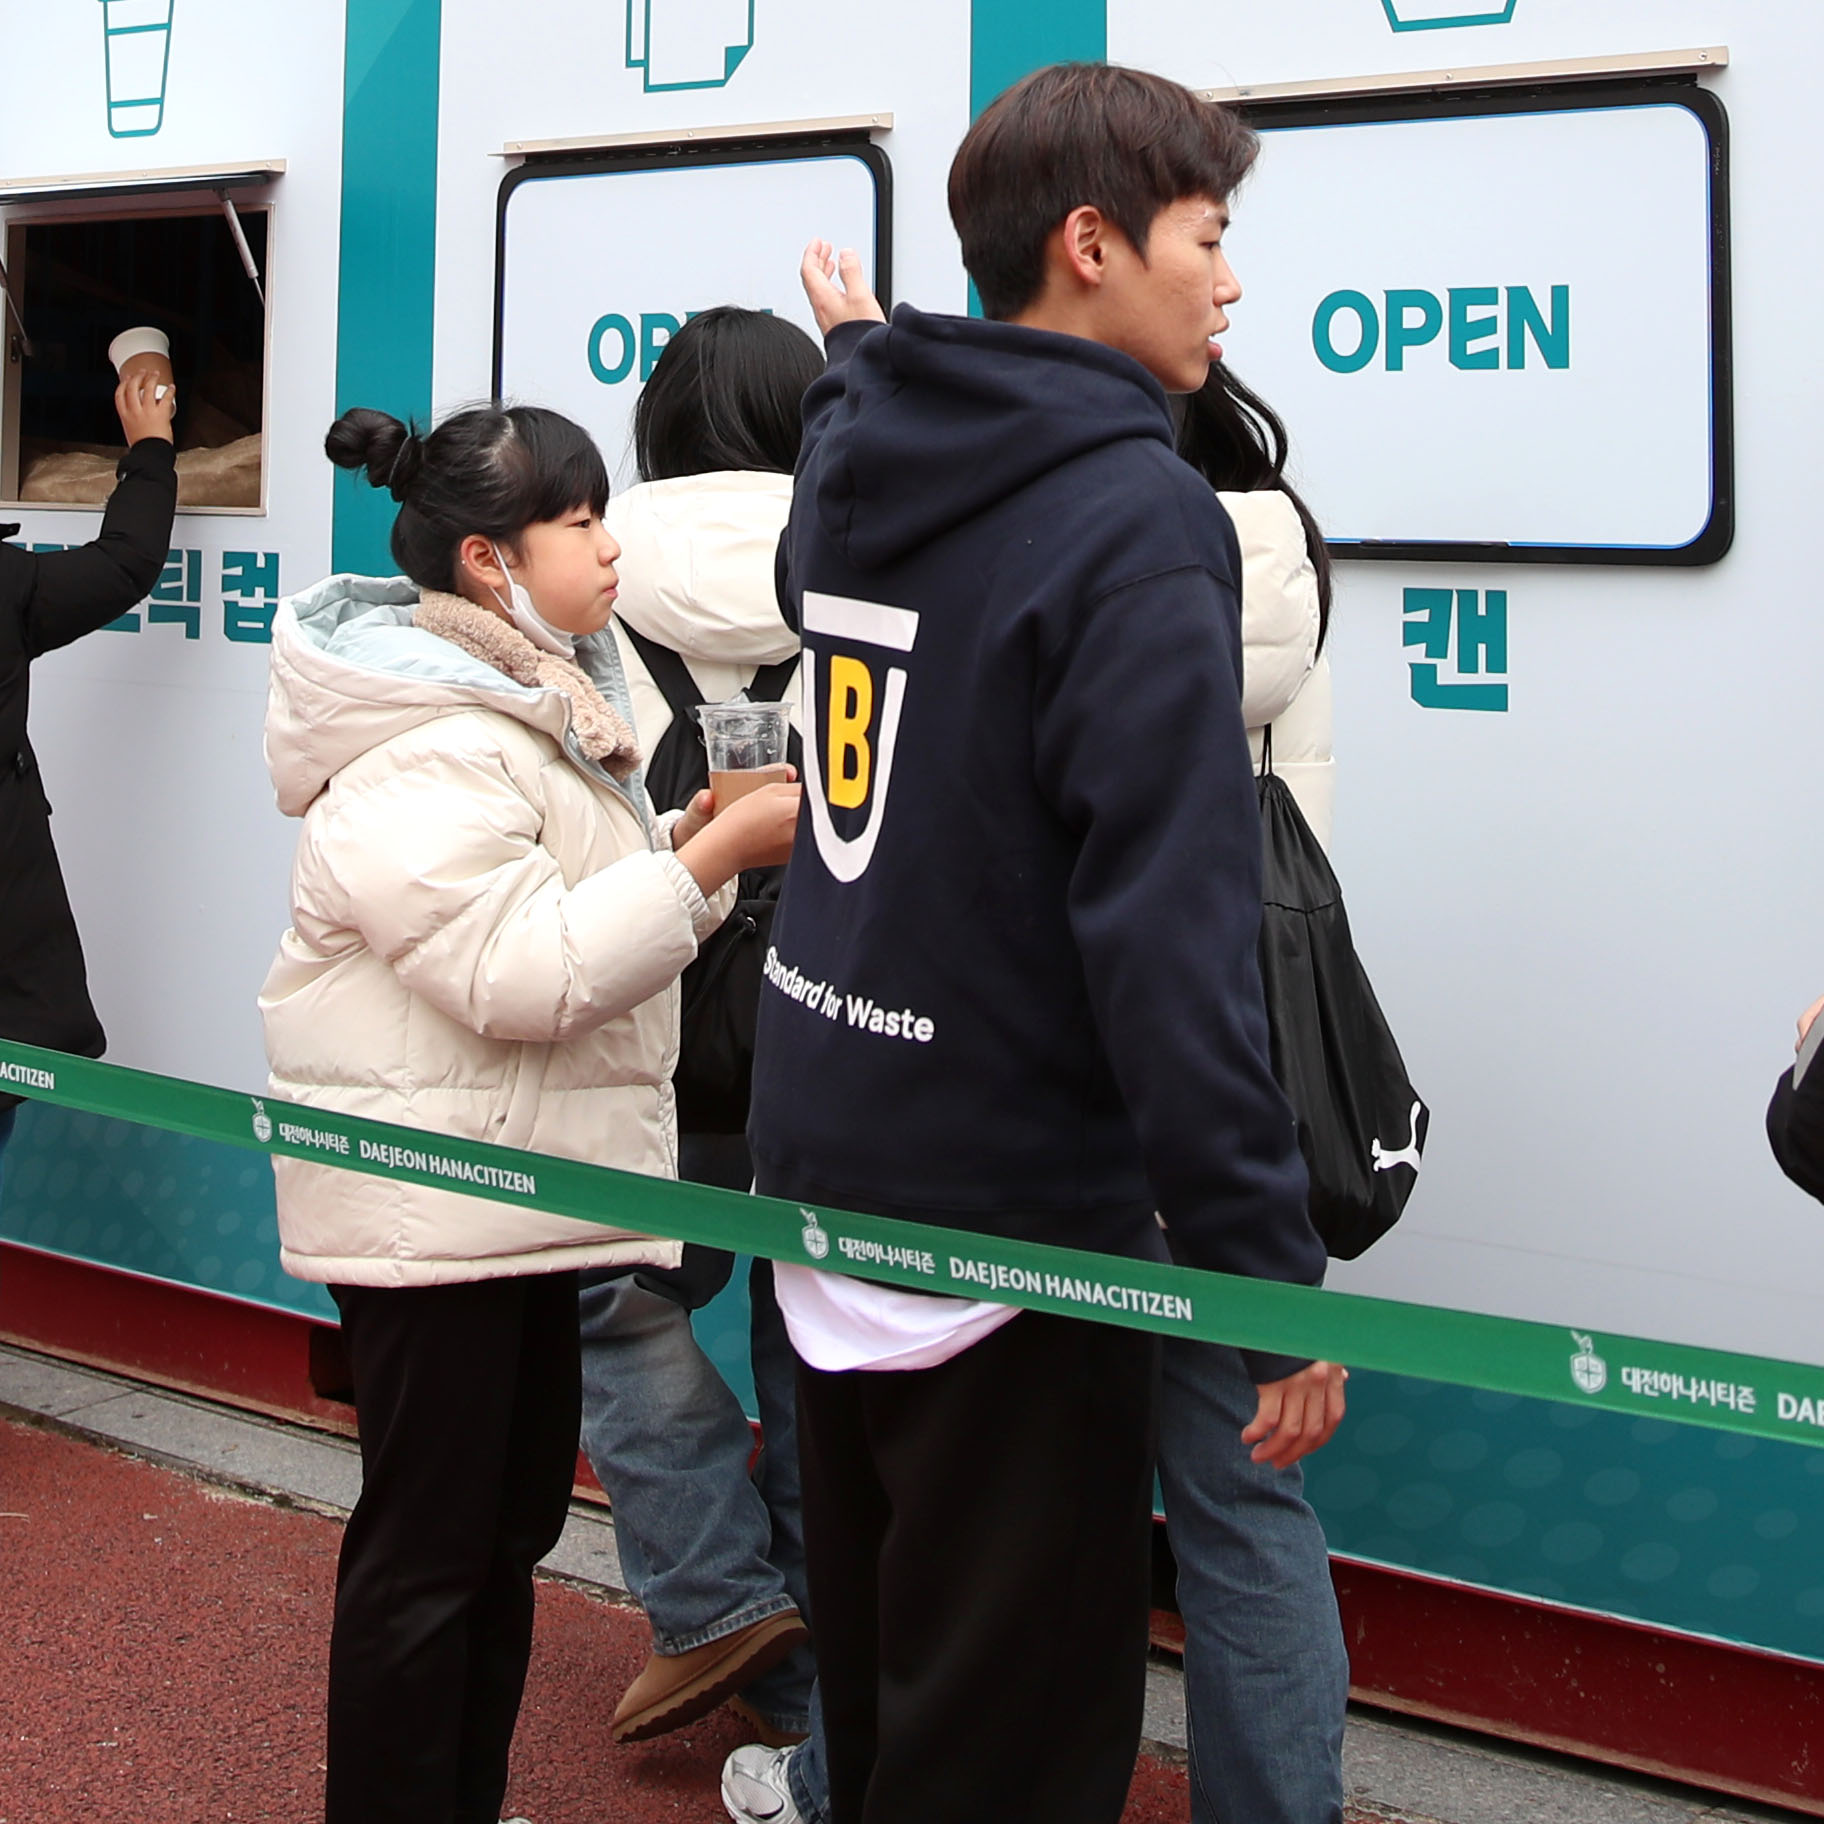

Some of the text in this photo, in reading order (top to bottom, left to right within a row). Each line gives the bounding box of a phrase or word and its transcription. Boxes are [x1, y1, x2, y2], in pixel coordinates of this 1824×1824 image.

[587, 308, 774, 386] OP
[1311, 284, 1571, 373] OPEN
[221, 550, 281, 644] 컵
[1403, 587, 1509, 713] 캔
[763, 945, 936, 1043] Standard for Waste
[359, 1139, 427, 1172] DAEJEON
[428, 1154, 536, 1195] HANACITIZEN
[949, 1256, 1043, 1295] DAEJEON
[1045, 1274, 1194, 1322] HANACITIZEN
